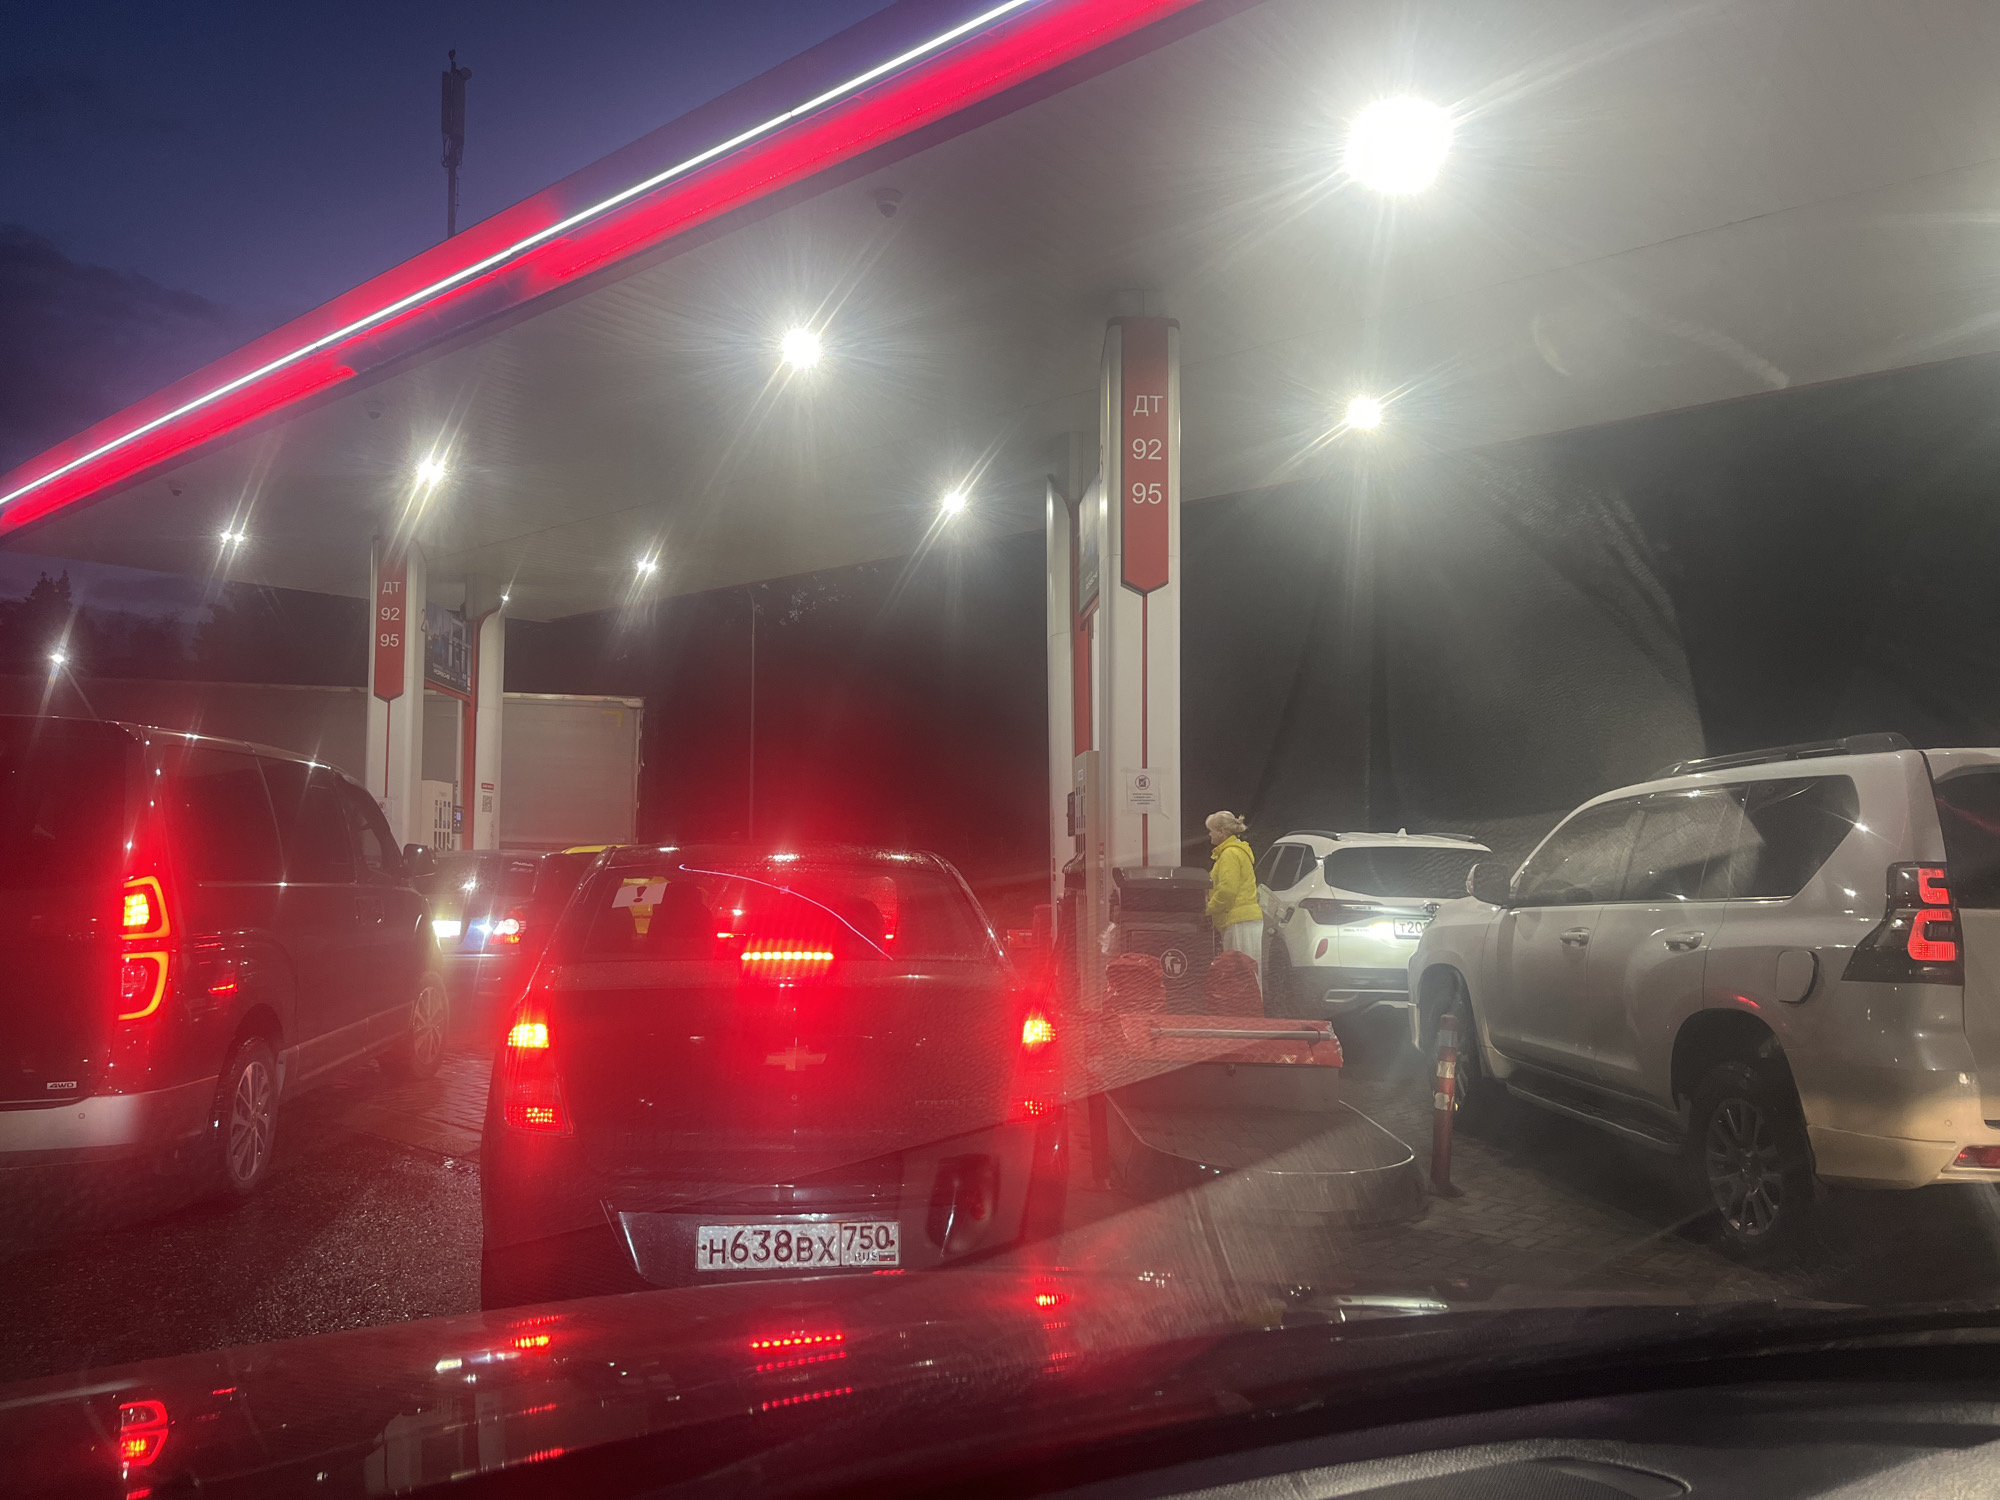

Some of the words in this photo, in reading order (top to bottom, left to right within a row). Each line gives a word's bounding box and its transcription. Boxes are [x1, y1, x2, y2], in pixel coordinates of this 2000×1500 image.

[1133, 395, 1163, 416] ДТ
[1132, 438, 1162, 460] 92
[1132, 482, 1162, 504] 95
[382, 581, 401, 595] ДТ
[381, 607, 400, 621] 92
[380, 633, 399, 647] 95
[843, 1225, 890, 1251] 750
[854, 1252, 878, 1262] RUS
